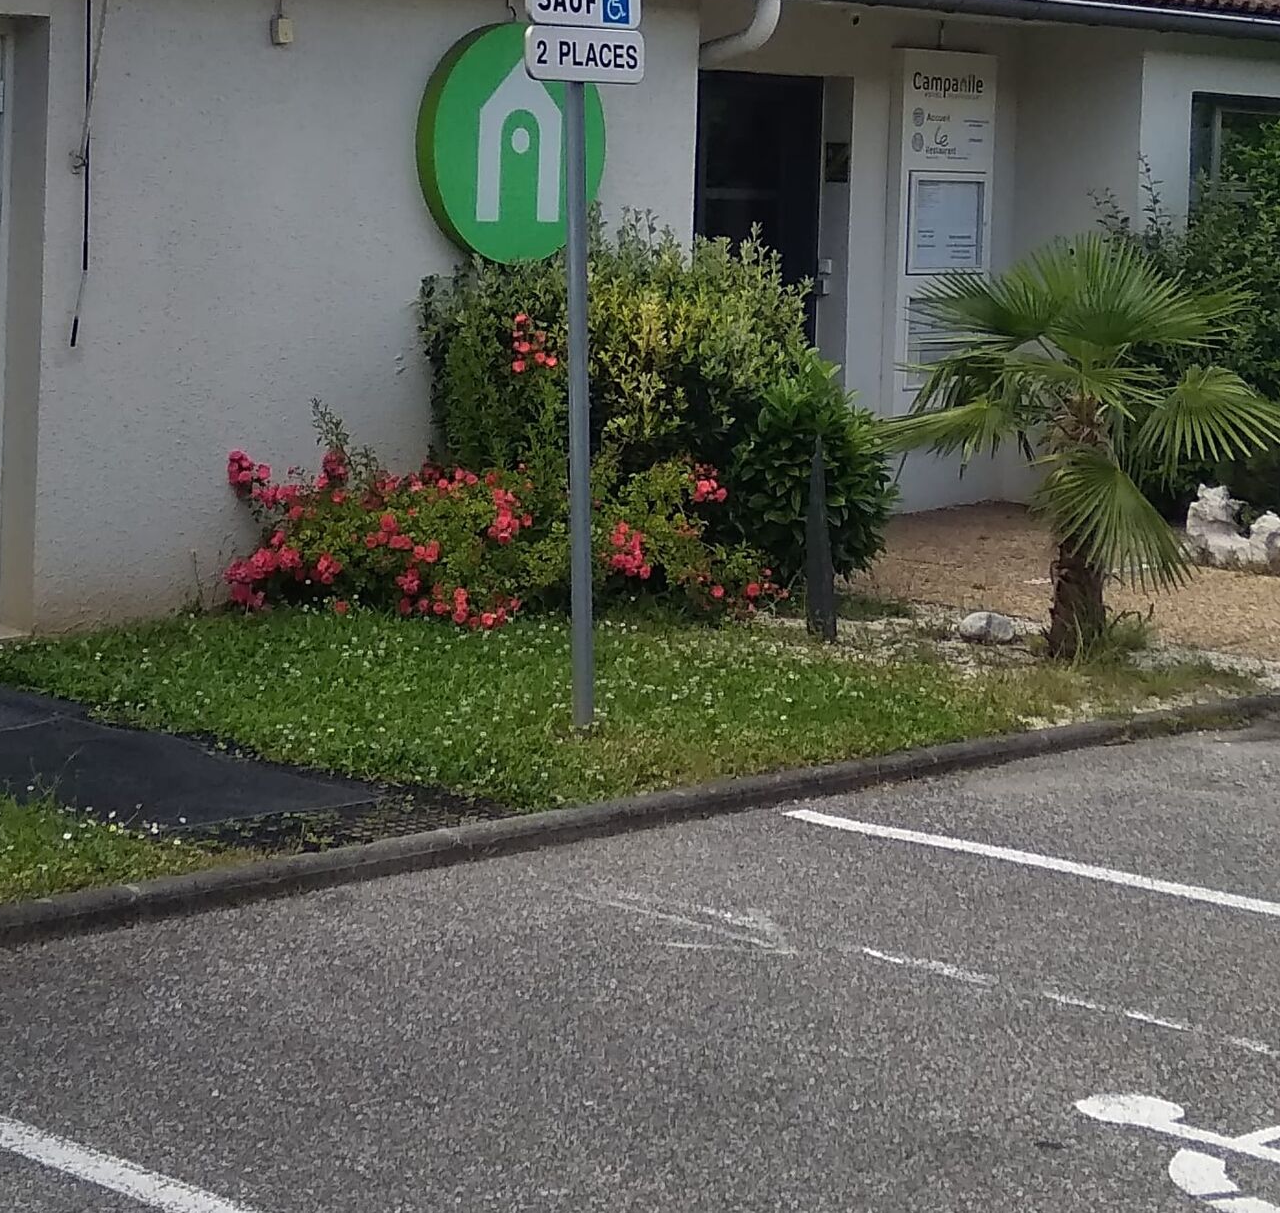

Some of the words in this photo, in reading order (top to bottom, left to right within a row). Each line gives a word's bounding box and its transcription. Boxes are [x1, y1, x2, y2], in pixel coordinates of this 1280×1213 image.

[536, 40, 548, 65] 2
[559, 41, 638, 69] PLACES
[913, 72, 984, 98] Campanile
